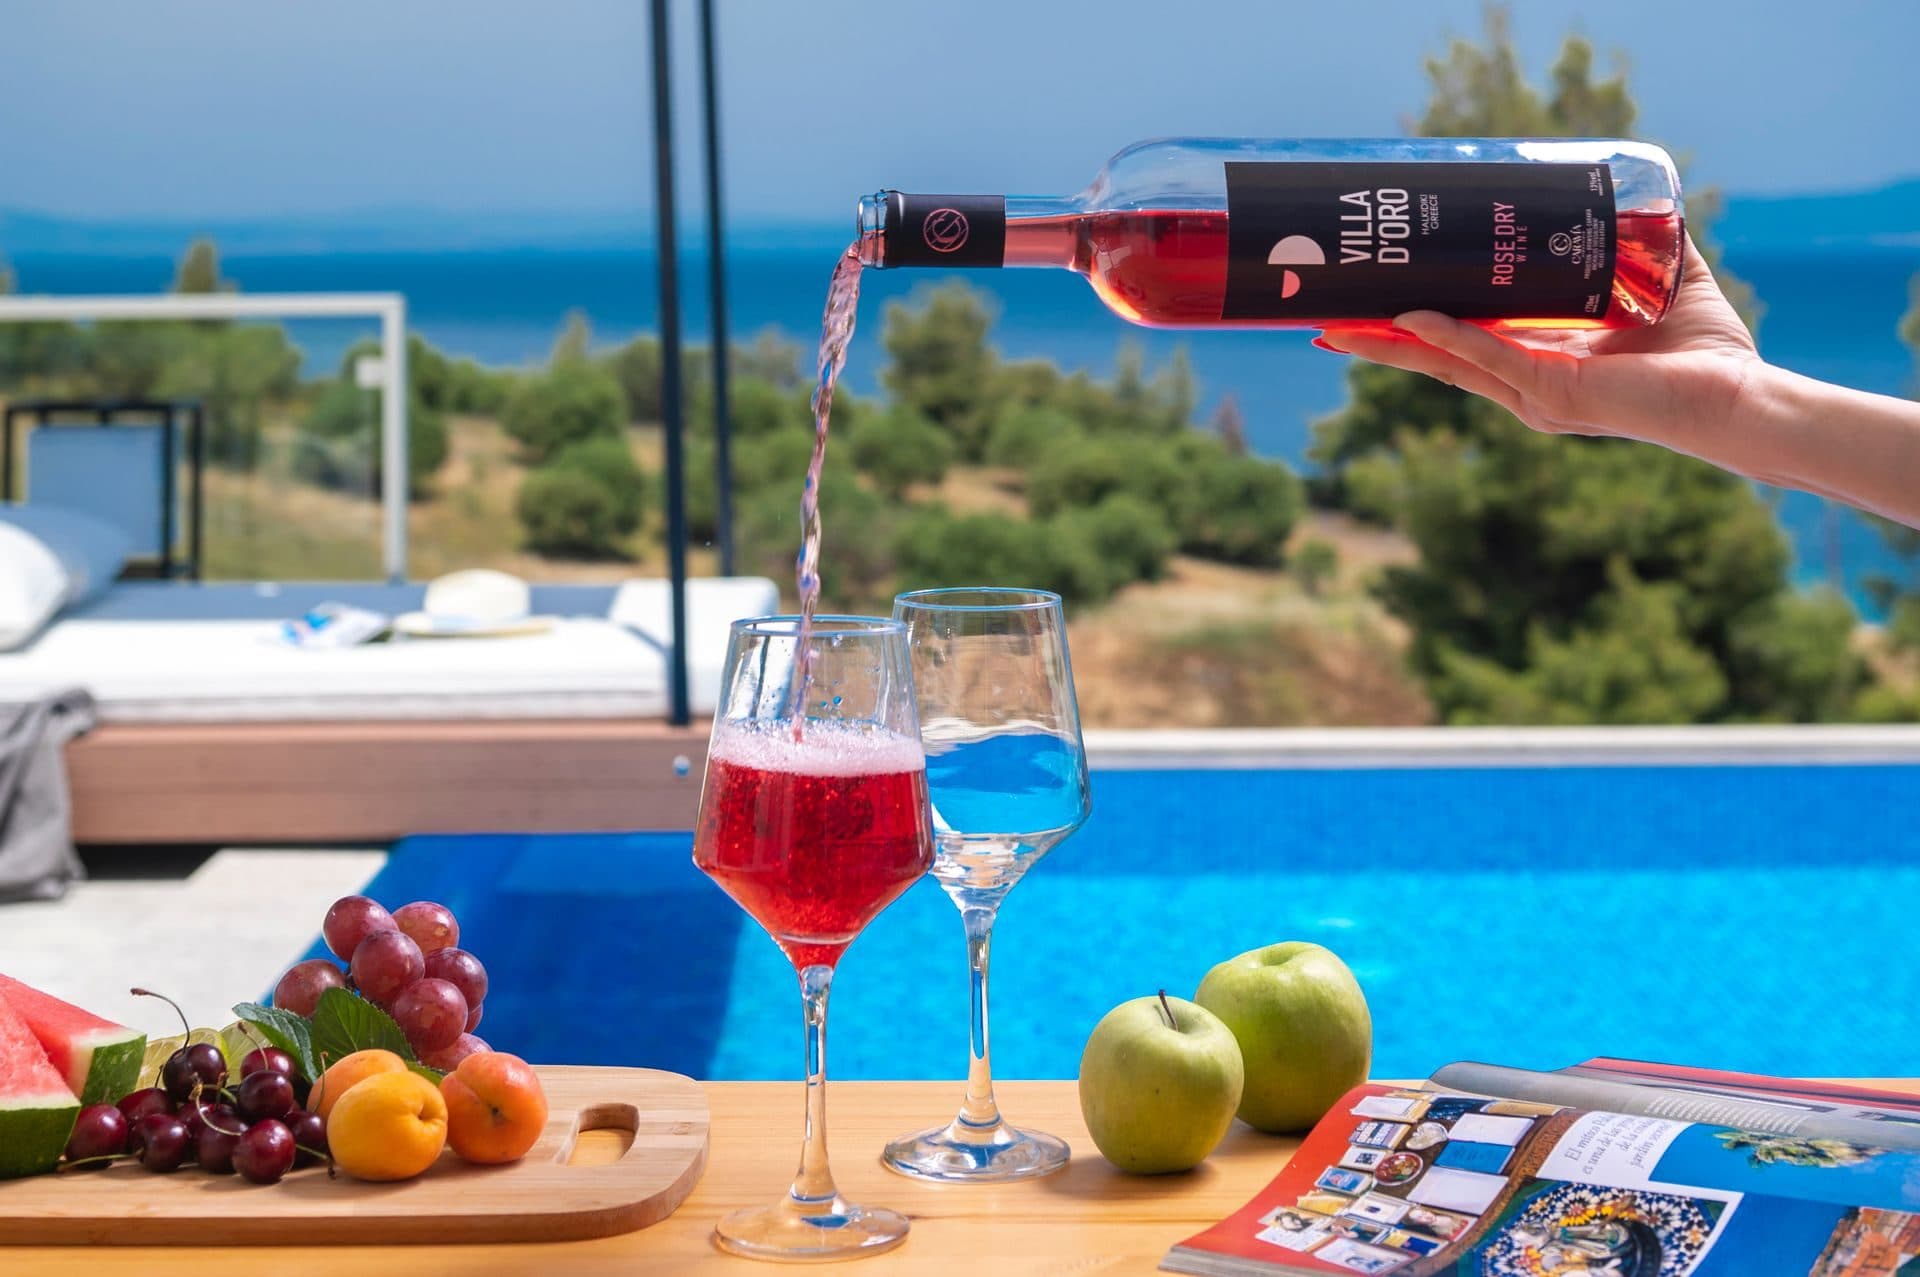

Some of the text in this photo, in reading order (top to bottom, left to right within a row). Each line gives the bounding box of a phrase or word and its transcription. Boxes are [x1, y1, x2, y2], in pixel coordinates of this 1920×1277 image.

[1340, 189, 1373, 265] VILLA
[1376, 188, 1410, 264] D'ORO
[1420, 194, 1430, 236] HALKIDIKI
[1429, 194, 1439, 230] GREECE
[1491, 202, 1516, 286] ROSE DRY
[1516, 225, 1528, 264] WINE
[1564, 1147, 1582, 1161] El
